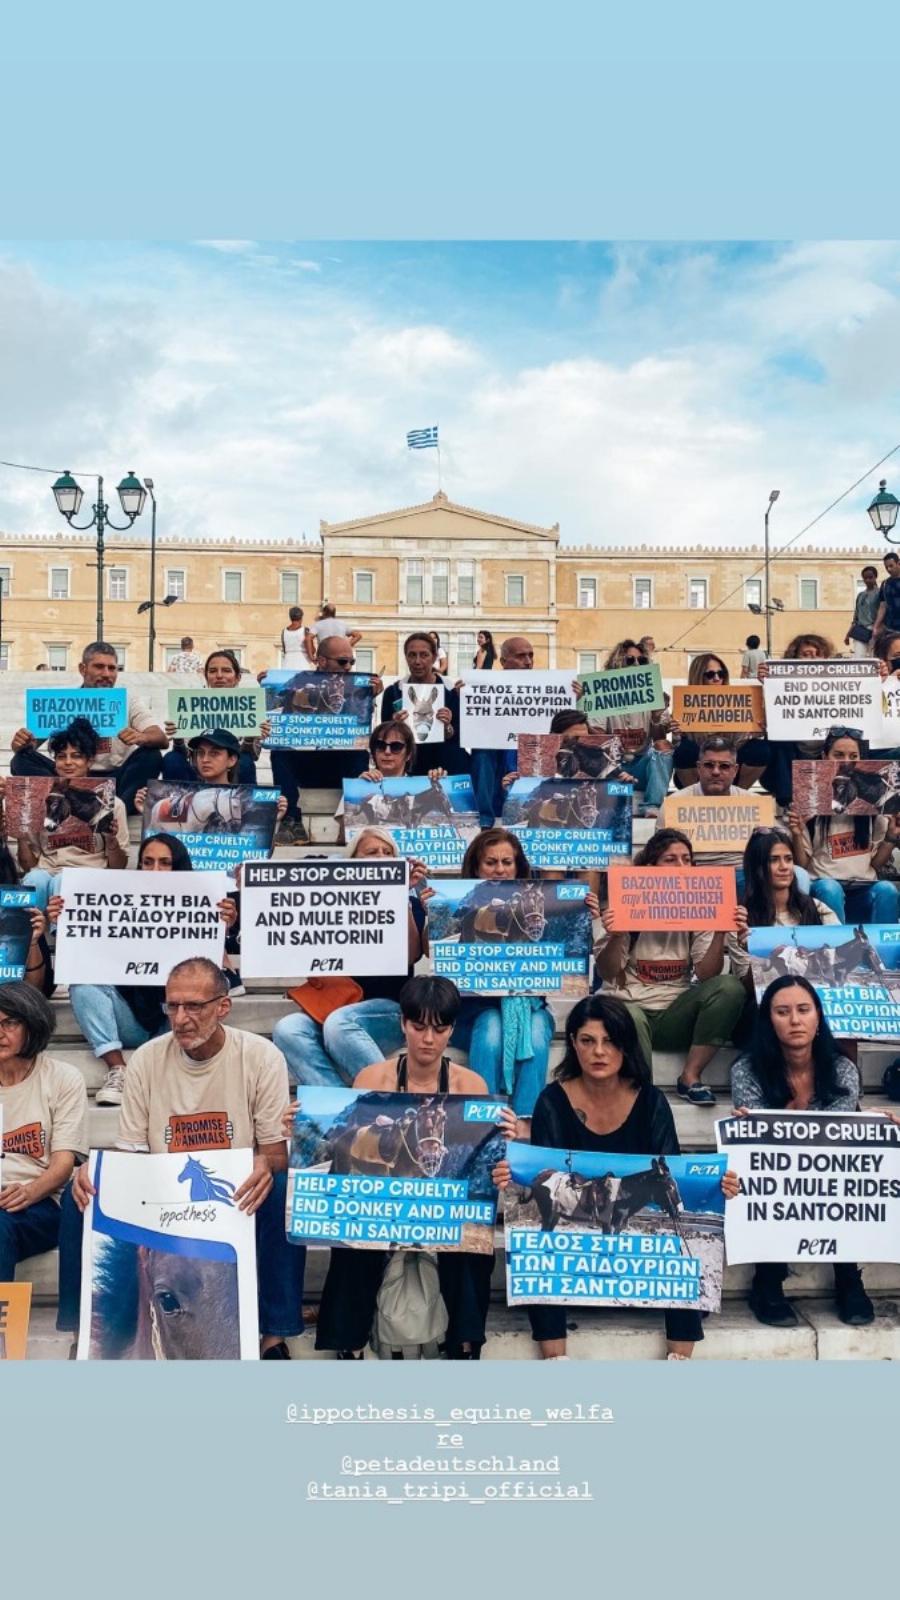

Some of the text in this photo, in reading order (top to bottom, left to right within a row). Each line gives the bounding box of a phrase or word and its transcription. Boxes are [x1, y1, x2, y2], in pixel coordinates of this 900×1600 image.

[768, 664, 876, 675] HELP STOP CRUELTY:
[471, 685, 566, 695] ΤΕΛΟΣ ΣΤΗ ΒΙΑ
[582, 672, 653, 695] A PROMISE
[784, 681, 861, 692] END DONKEY
[32, 697, 105, 713] ΒΓΑΖΟΥΜΕ
[177, 696, 256, 712] A PROMISE
[465, 694, 572, 706] ΤΩΝ ΓΑΪΔΟΥΡΙΩΝ
[583, 688, 655, 712] to ANIMALS
[683, 694, 753, 708] ΒΛΕΠΟΥΜΕ
[774, 694, 872, 706] AND MULE RIDES
[465, 706, 562, 717] ΣΤΗ ΣΑΝΤΟΡΙΝ
[698, 709, 753, 723] ΑΛΗΘΕΙΑ
[782, 708, 864, 719] IN SANTORINI
[37, 714, 117, 729] ΠΑΡΔΕΣ
[177, 713, 257, 730] to ANIMALS
[288, 715, 312, 724] STOP
[270, 726, 284, 734] ND
[285, 727, 322, 735] DONKEY
[325, 727, 345, 736] AND
[292, 737, 301, 745] IN
[303, 737, 353, 746] SANTORINI
[677, 806, 760, 823] ΒΛΕΠΟΥΜΕ
[204, 834, 253, 846] CRUELTY:
[399, 828, 426, 840] ΣΤΗ
[430, 828, 453, 839] ΒΙΑ
[535, 830, 561, 839] STOP
[564, 830, 612, 840] CRUELTY:
[695, 824, 754, 841] ΑΛΗΘΕΙ
[187, 846, 269, 859] NKEY AND MULE
[400, 840, 465, 852] ΪΔΟΥΡΙΩΝ
[531, 843, 574, 852] DONKEY
[576, 844, 600, 852] AND
[602, 844, 629, 853] MULE
[191, 860, 236, 870] SANTOR
[539, 856, 551, 864] IN
[552, 856, 609, 865] SANTORINI
[249, 866, 402, 882] HELP STOP CRUELTY:
[622, 876, 723, 889] ΒΑΖΟΥΜΕ ΤΕΛΟΣ
[74, 892, 212, 908] ΤΕΛΟΣ ΣΤΗ ΒΙΑ
[270, 891, 381, 907] END DONKEY
[642, 891, 724, 905] ΚΑΚΟΠΟΙΗΣΗ
[65, 907, 220, 924] ΤΩΝ ΓΑΪΔΟΥΡΙΩΝ
[255, 909, 395, 927] AND MULE RIDES
[648, 906, 717, 920] ΙΠΠΟΕΙΔΩΝ
[65, 925, 218, 940] ΣΤΗ ΣΑΝΤΟΡΙΝΗ!
[267, 929, 384, 946] IN SANTORINI
[435, 944, 563, 957] HELP STOP CRUELTY:
[435, 961, 585, 973] END DONKEY AND MULE
[474, 976, 488, 988] IN
[490, 976, 560, 988] SANTORINI
[823, 988, 886, 1001] ΣΤΗ ΒΙΑ
[824, 1001, 900, 1017] ΪΔΟΥΡΙΩΝ
[180, 1119, 224, 1133] PROMISE
[725, 1119, 769, 1139] HELP
[772, 1121, 821, 1140] STOP
[3, 1130, 38, 1148] ROMISE
[182, 1131, 225, 1147] ANIMALS
[750, 1151, 884, 1173] END DONKEY
[296, 1176, 465, 1199] HELP STOP CRUELTY:
[783, 1177, 839, 1197] MULE
[843, 1179, 900, 1199] RIDES
[160, 1203, 217, 1228] ippothesis
[294, 1198, 492, 1221] END DONKEY AND MULE
[747, 1201, 886, 1223] IN SANTORINI
[293, 1220, 460, 1241] RIDES IN SANTORINI
[512, 1232, 678, 1255] ΤΕΛΟΣ ΣΤΗ ΒΙΑ
[512, 1254, 698, 1277] ΤΩΝ ΓΑΪΔΟΥΡΙΩΝ
[512, 1276, 695, 1299] ΣΤΗ ΣΑΝΤΟΡΙΝΗ!
